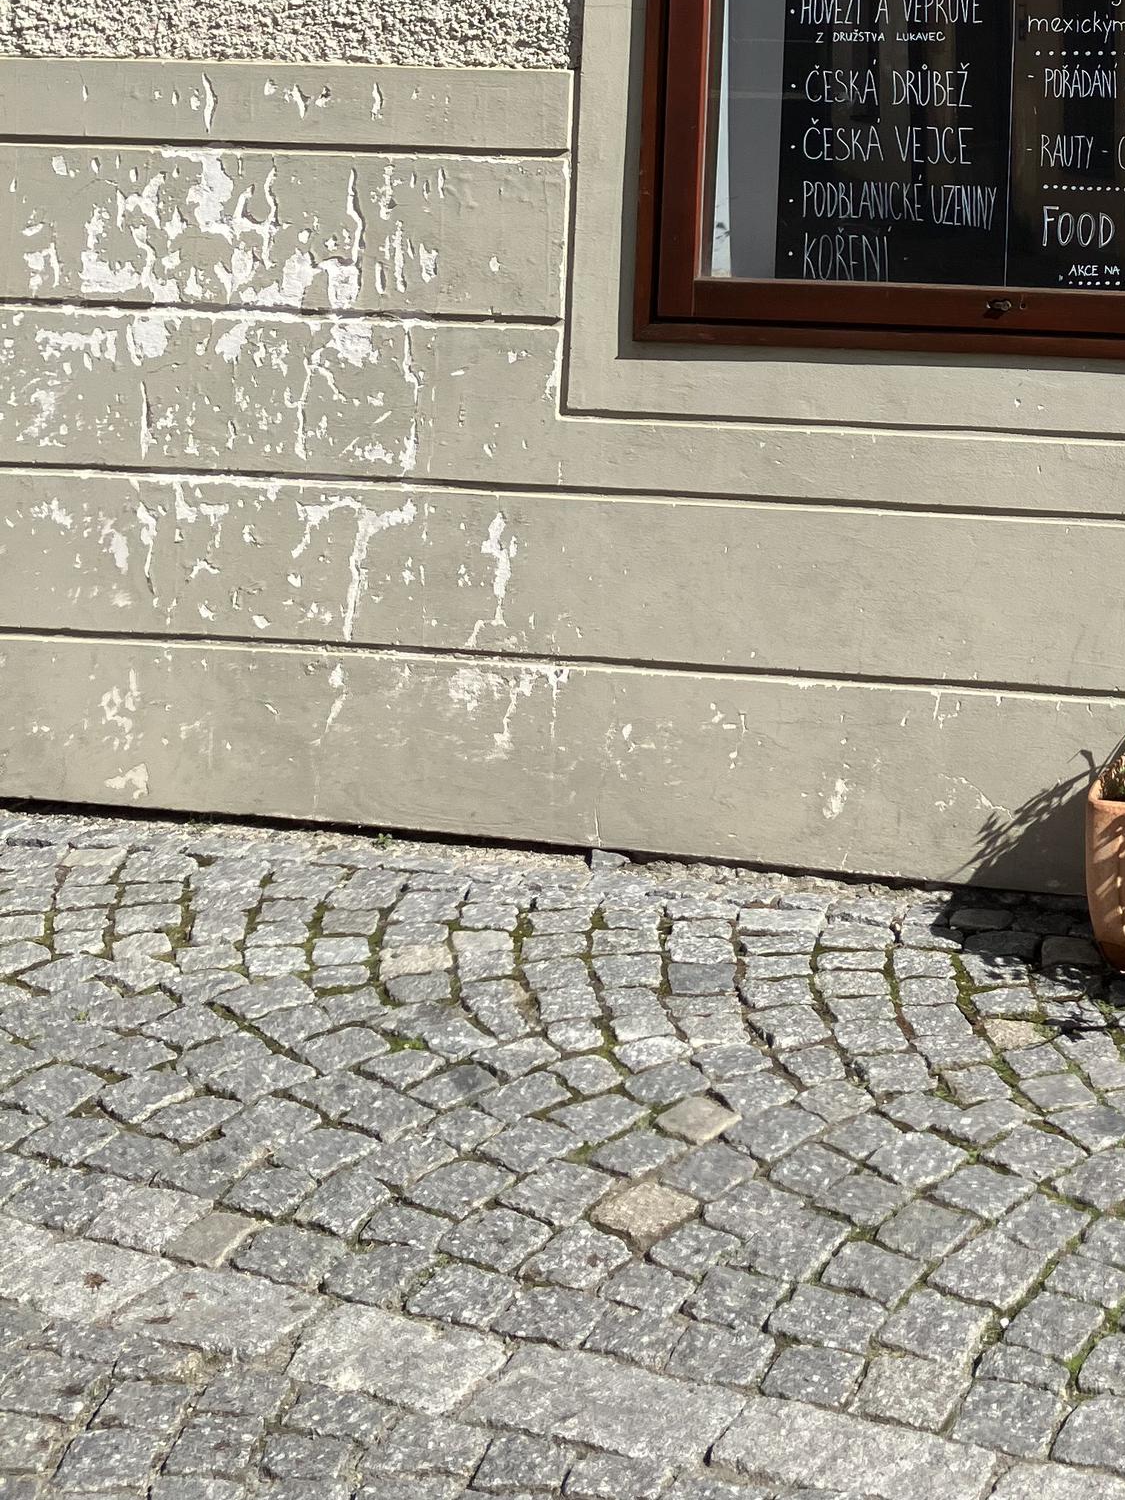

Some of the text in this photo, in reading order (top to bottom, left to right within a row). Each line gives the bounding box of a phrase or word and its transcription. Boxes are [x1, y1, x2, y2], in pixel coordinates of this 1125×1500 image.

[815, 29, 946, 43] Z DRUŽSTVA LUKAVEC
[805, 59, 973, 107] ČESKÁ DRŮBEŽ
[1044, 62, 1118, 99] POŘÁDÁNÍ
[803, 117, 974, 164] ČESKÁ VEJCE
[1040, 134, 1094, 168] RAUTY
[802, 174, 997, 231] PODBLANICKÉ UZENINY
[1042, 205, 1116, 249] FOOD
[803, 226, 892, 281] KOŘENÍ
[1104, 265, 1120, 275] NA
